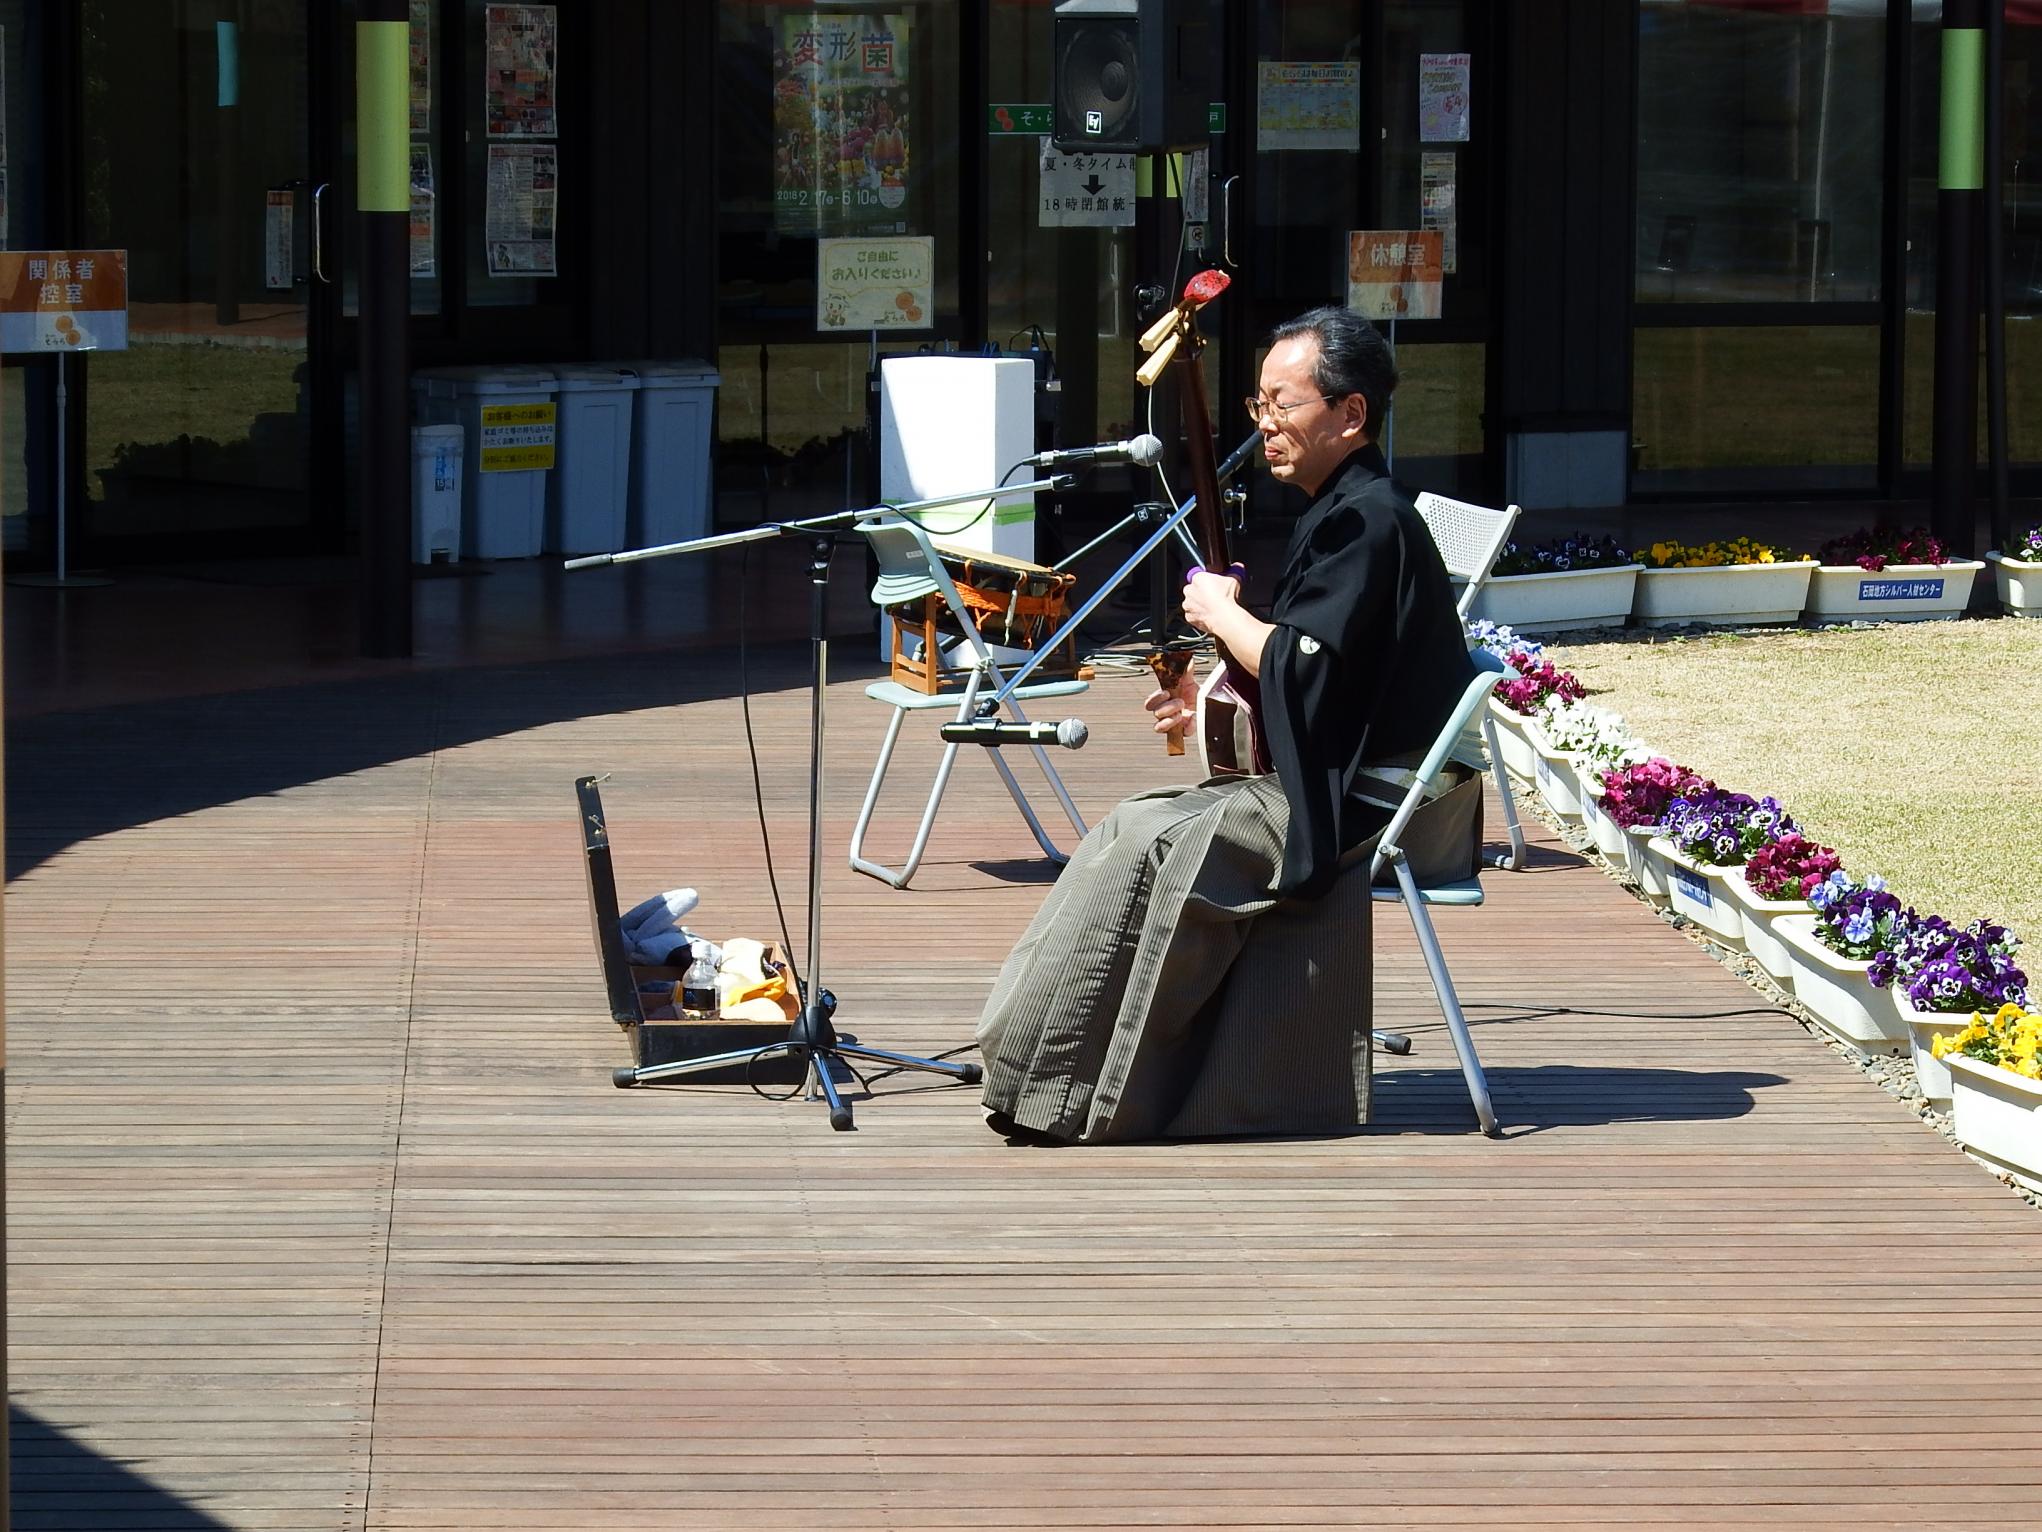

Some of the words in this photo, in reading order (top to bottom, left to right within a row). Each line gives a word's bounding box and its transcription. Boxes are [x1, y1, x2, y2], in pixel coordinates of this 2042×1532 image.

[792, 30, 895, 73] 変形菌
[857, 250, 899, 263] ご自由に
[1371, 242, 1425, 267] 休憩室
[29, 258, 96, 281] 関係者
[40, 283, 84, 305] 控室
[1862, 583, 1941, 598] 石岡地方シルバー人材センター
